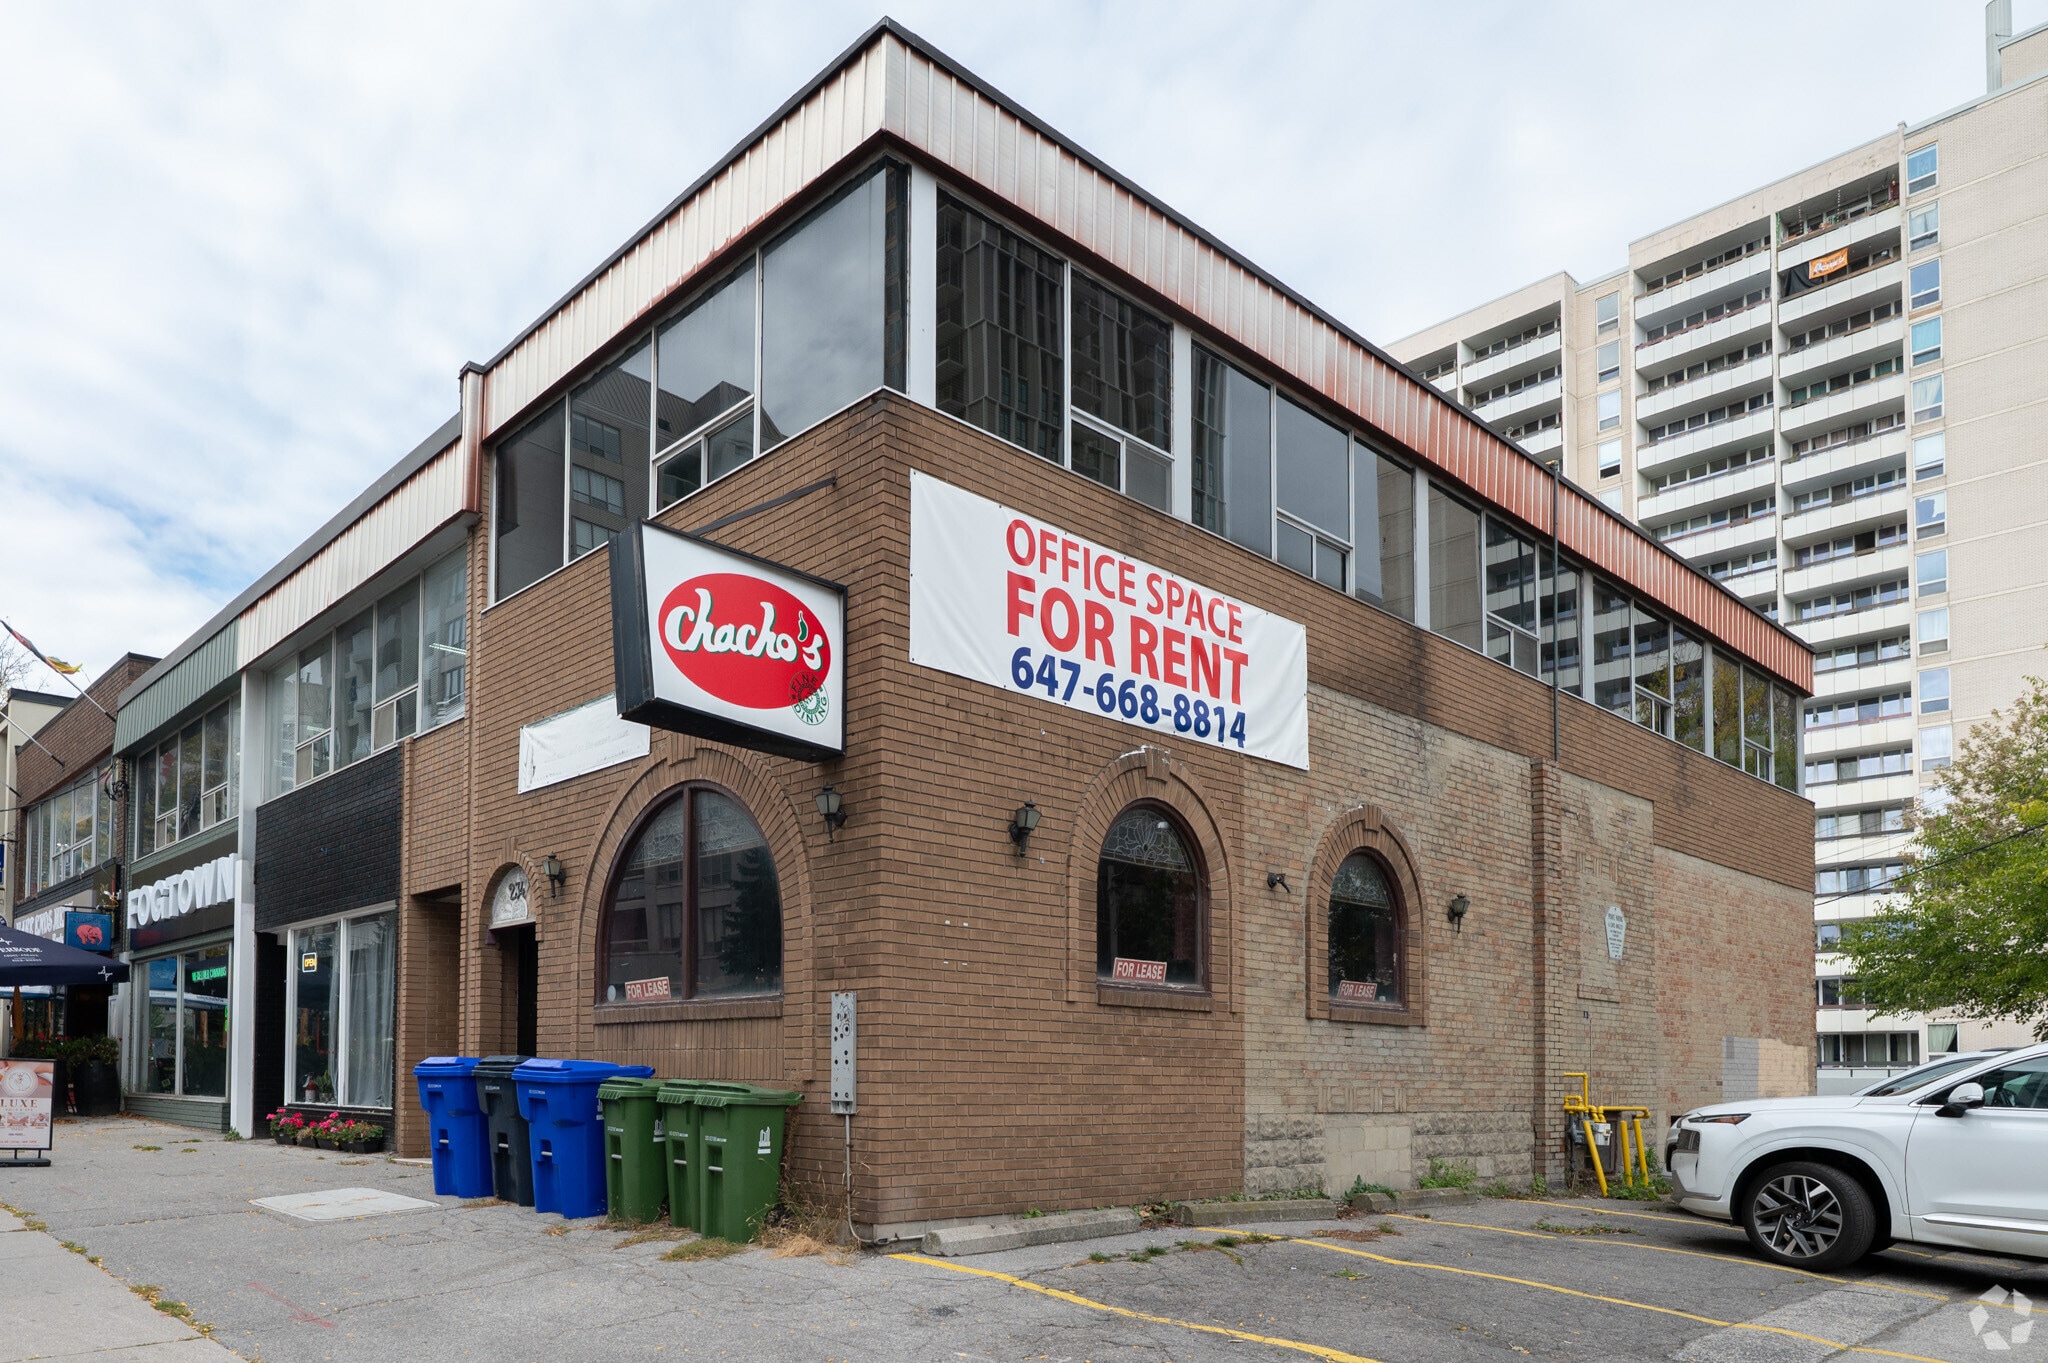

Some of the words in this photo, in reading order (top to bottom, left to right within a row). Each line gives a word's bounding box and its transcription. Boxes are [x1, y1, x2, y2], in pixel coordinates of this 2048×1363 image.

[1006, 519, 1136, 607] OFFICE
[1147, 572, 1243, 645] SPACE
[665, 588, 824, 671] Chacho's
[1007, 571, 1115, 667] FOR
[1130, 615, 1249, 705] RENT
[791, 674, 818, 692] FINE
[1011, 647, 1246, 748] 647-668-8814
[794, 696, 827, 723] DINING
[127, 853, 238, 929] FOGTOWN
[626, 984, 642, 999] FOR
[643, 980, 669, 997] LEASE
[1116, 961, 1134, 978] FOR
[1136, 963, 1163, 980] LEASE
[1340, 983, 1354, 997] FOR
[1354, 985, 1375, 998] LEASE
